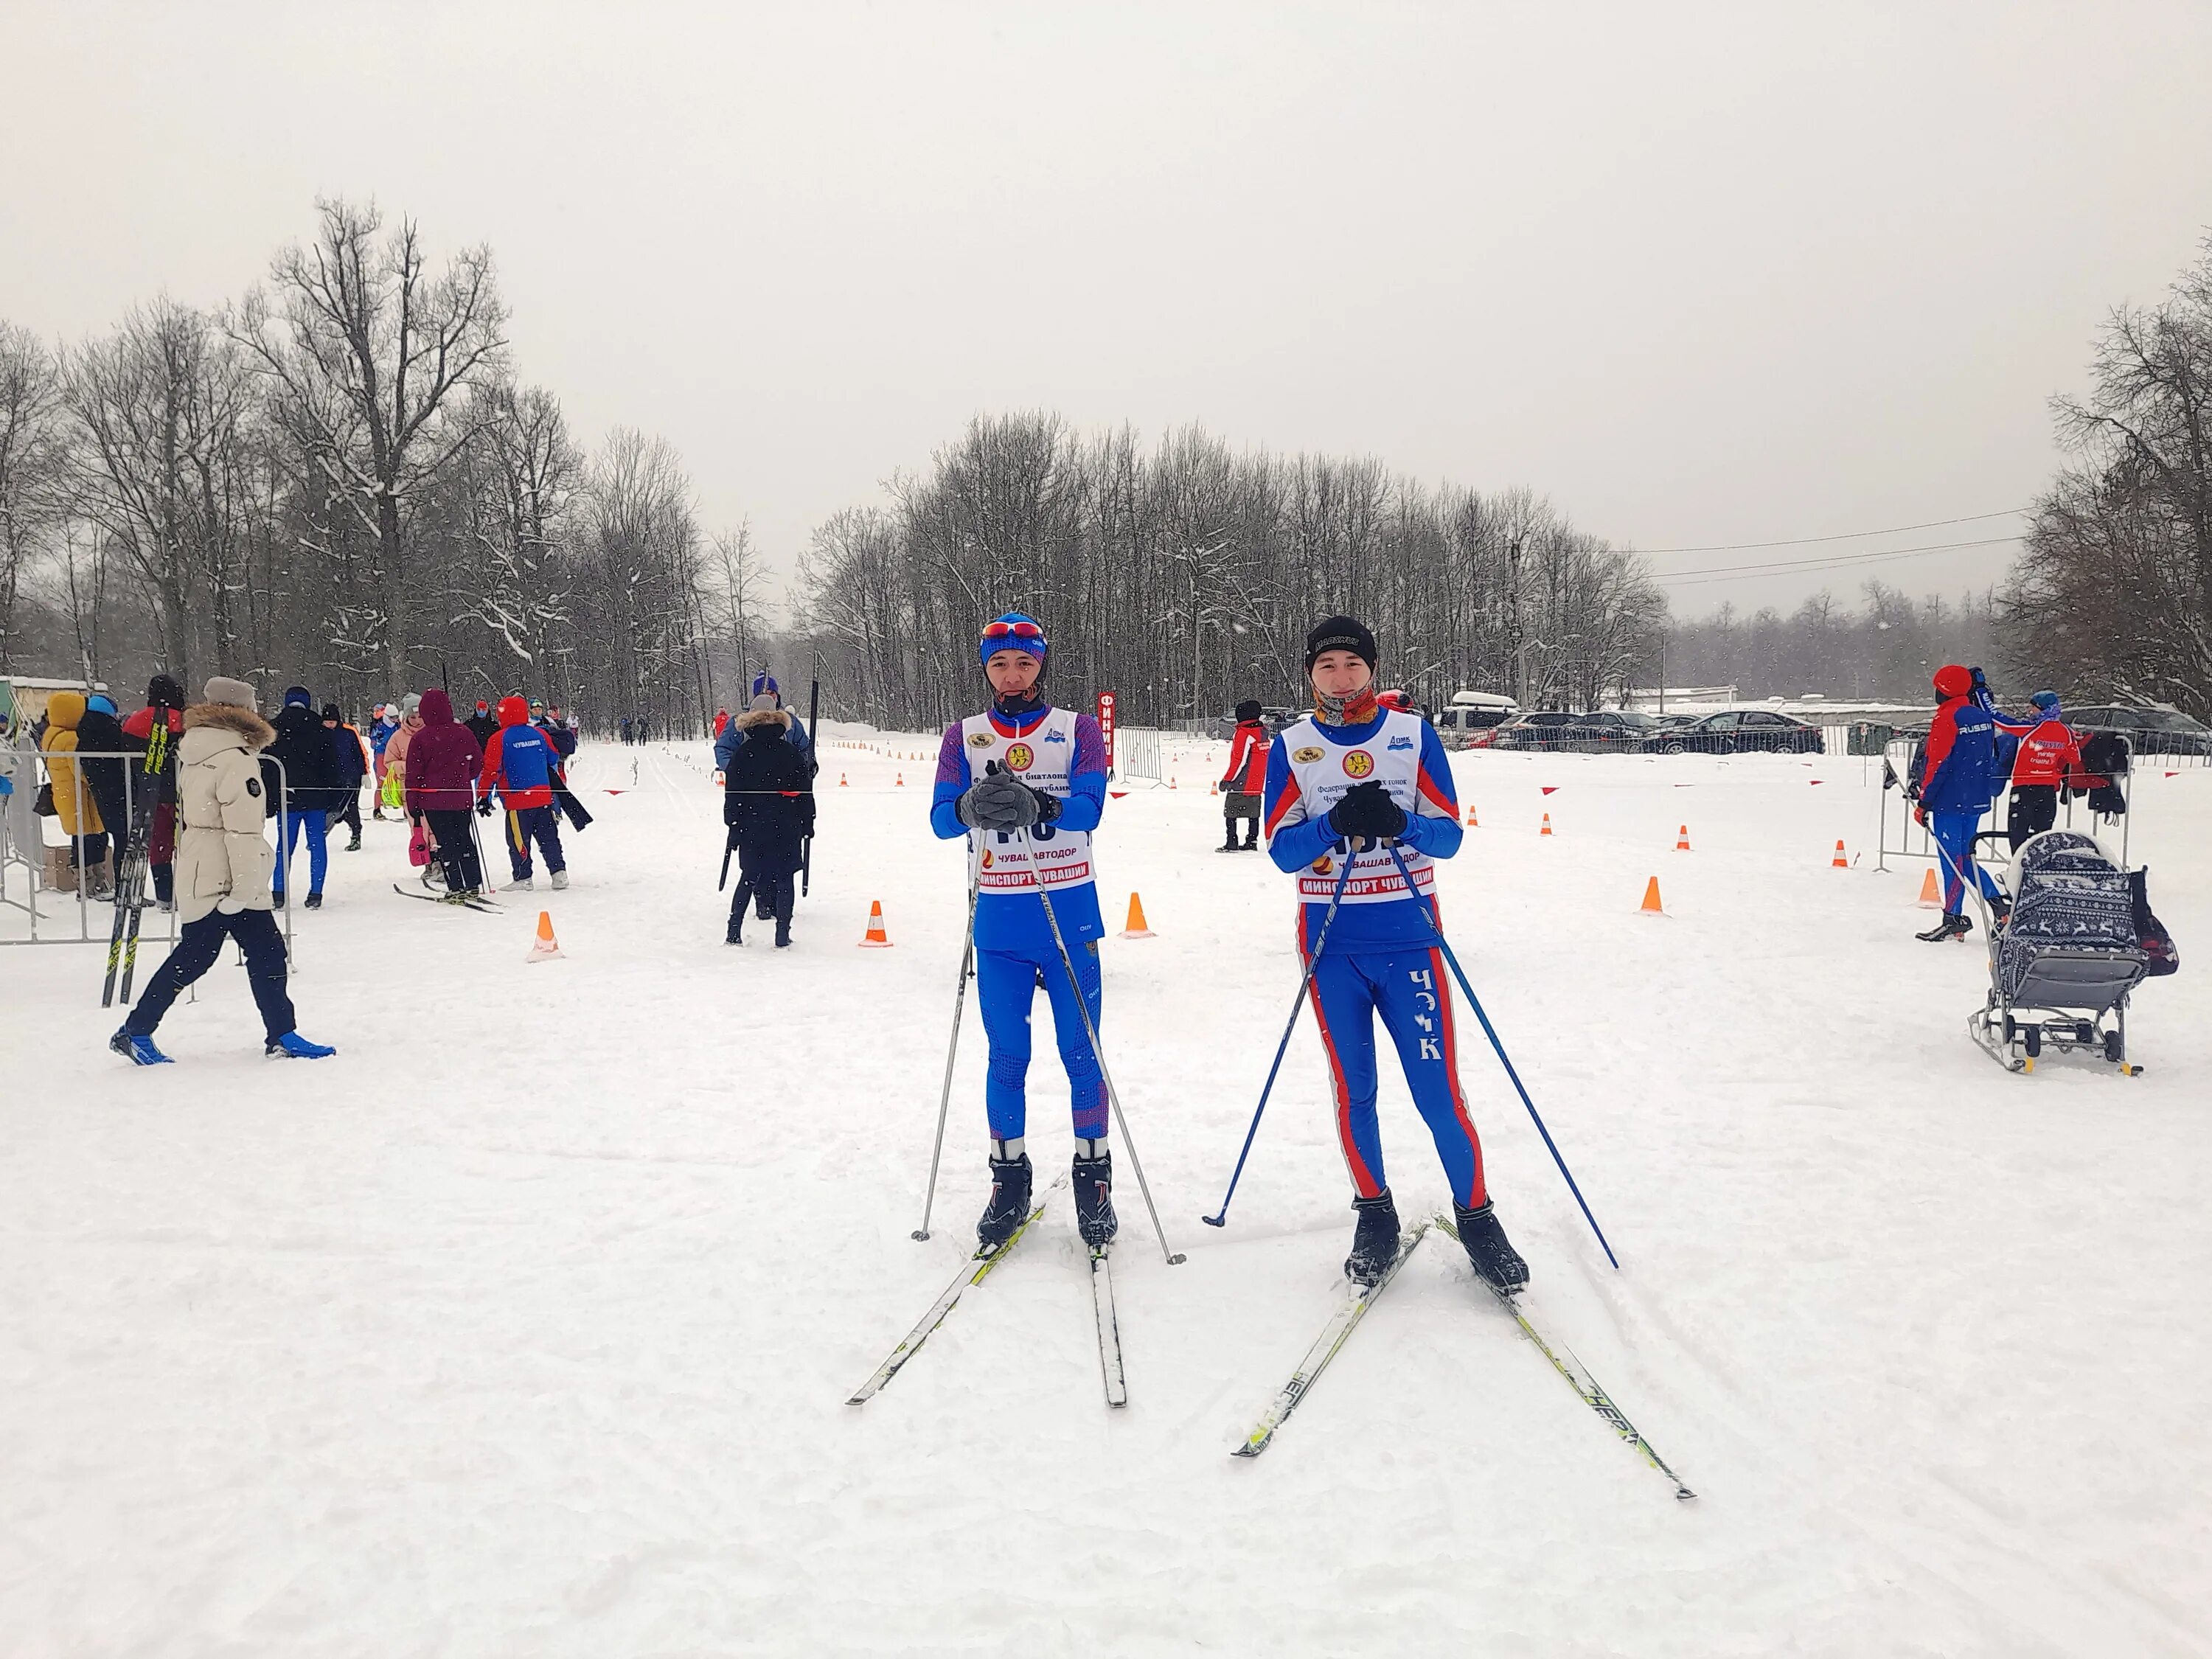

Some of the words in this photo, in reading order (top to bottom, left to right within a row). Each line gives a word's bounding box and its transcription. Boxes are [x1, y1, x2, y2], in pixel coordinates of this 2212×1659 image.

[1315, 636, 1360, 653] MADSHUS
[144, 722, 160, 775] FISCHER
[154, 724, 168, 776] FISCHER
[1025, 772, 1068, 781] биатлона
[1338, 852, 1420, 869] ЧВАШАВТДОР
[1380, 869, 1433, 891] ЧУВШИИ
